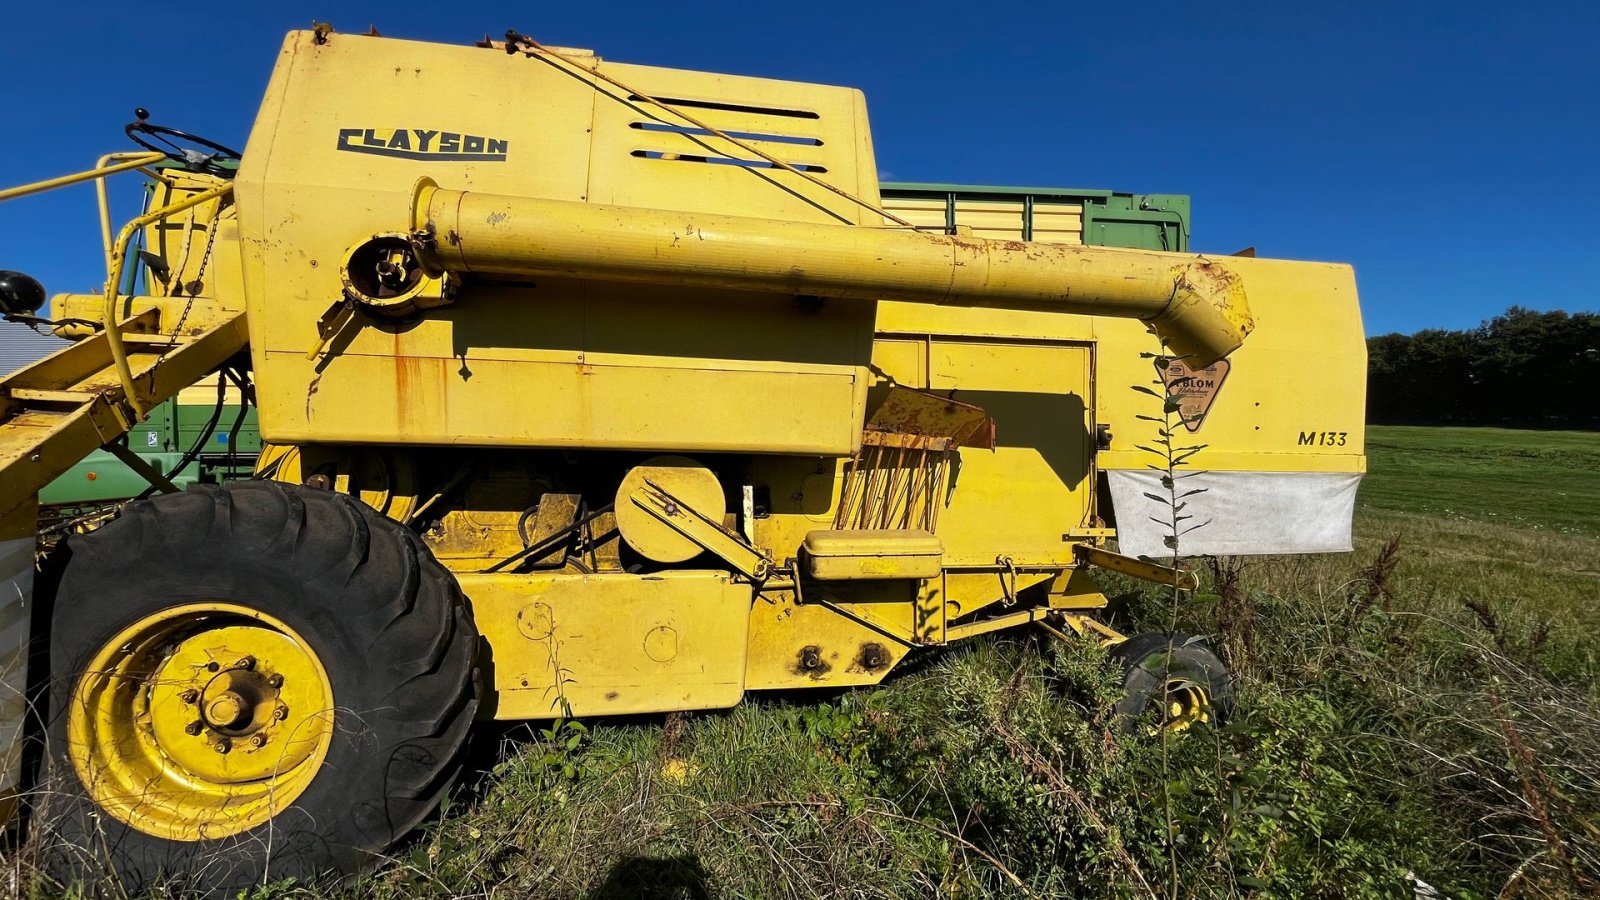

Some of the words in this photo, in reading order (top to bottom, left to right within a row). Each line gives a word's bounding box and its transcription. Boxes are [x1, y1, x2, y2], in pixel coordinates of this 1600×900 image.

[337, 128, 508, 161] CLAYSON
[1298, 431, 1316, 446] M
[1319, 431, 1348, 447] 133
